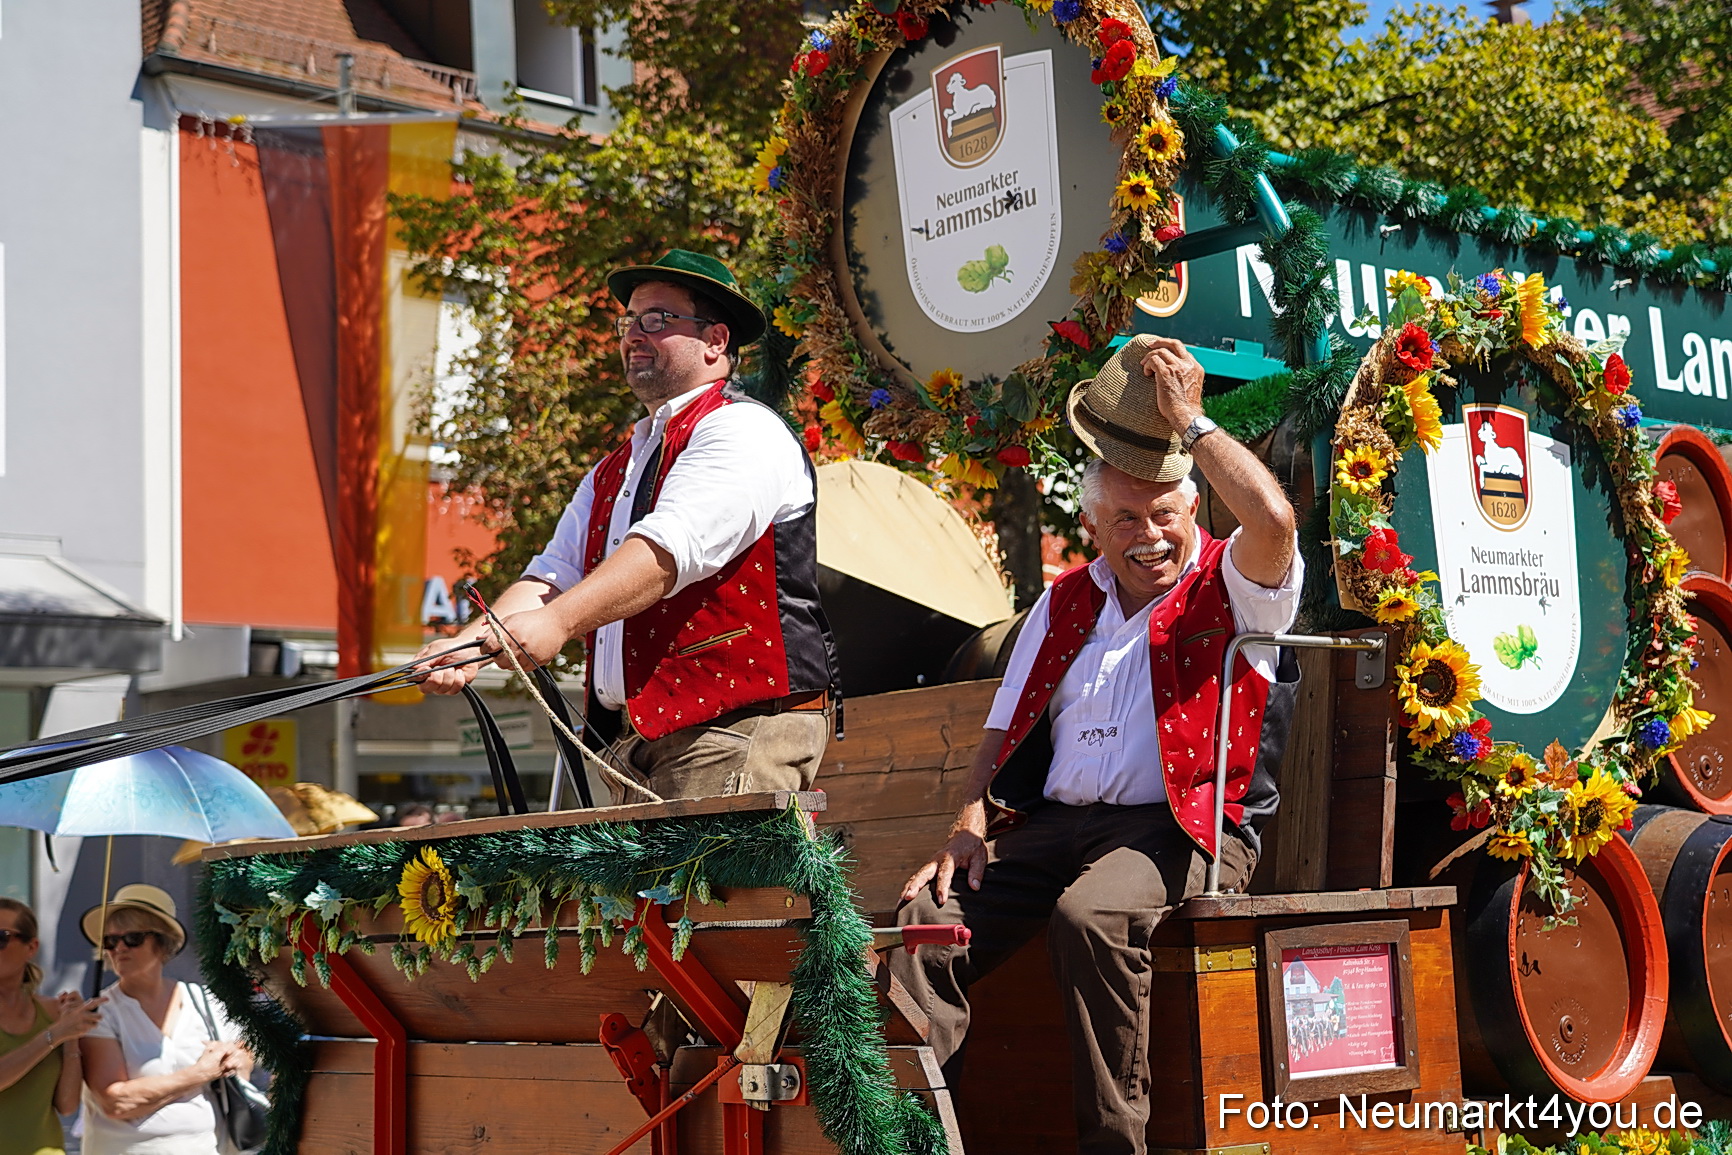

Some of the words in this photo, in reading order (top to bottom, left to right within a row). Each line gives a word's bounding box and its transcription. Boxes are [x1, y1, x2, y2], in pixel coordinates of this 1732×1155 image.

[959, 136, 988, 158] 1628
[936, 170, 1019, 211] Neumarkter
[924, 186, 1037, 242] Lammsbräu
[911, 257, 936, 312] ÖKOLOGISCH
[935, 310, 969, 327] GEBRAUT
[970, 317, 985, 327] MIT
[987, 311, 1006, 323] 100%
[1007, 212, 1057, 315] NATURDOLDENHOPFEN
[1490, 501, 1518, 519] 1628
[1471, 545, 1544, 568] Neumarkter
[1459, 567, 1560, 598] Lammsbräu
[1482, 683, 1505, 702] BRAUT
[1507, 697, 1519, 707] MIT
